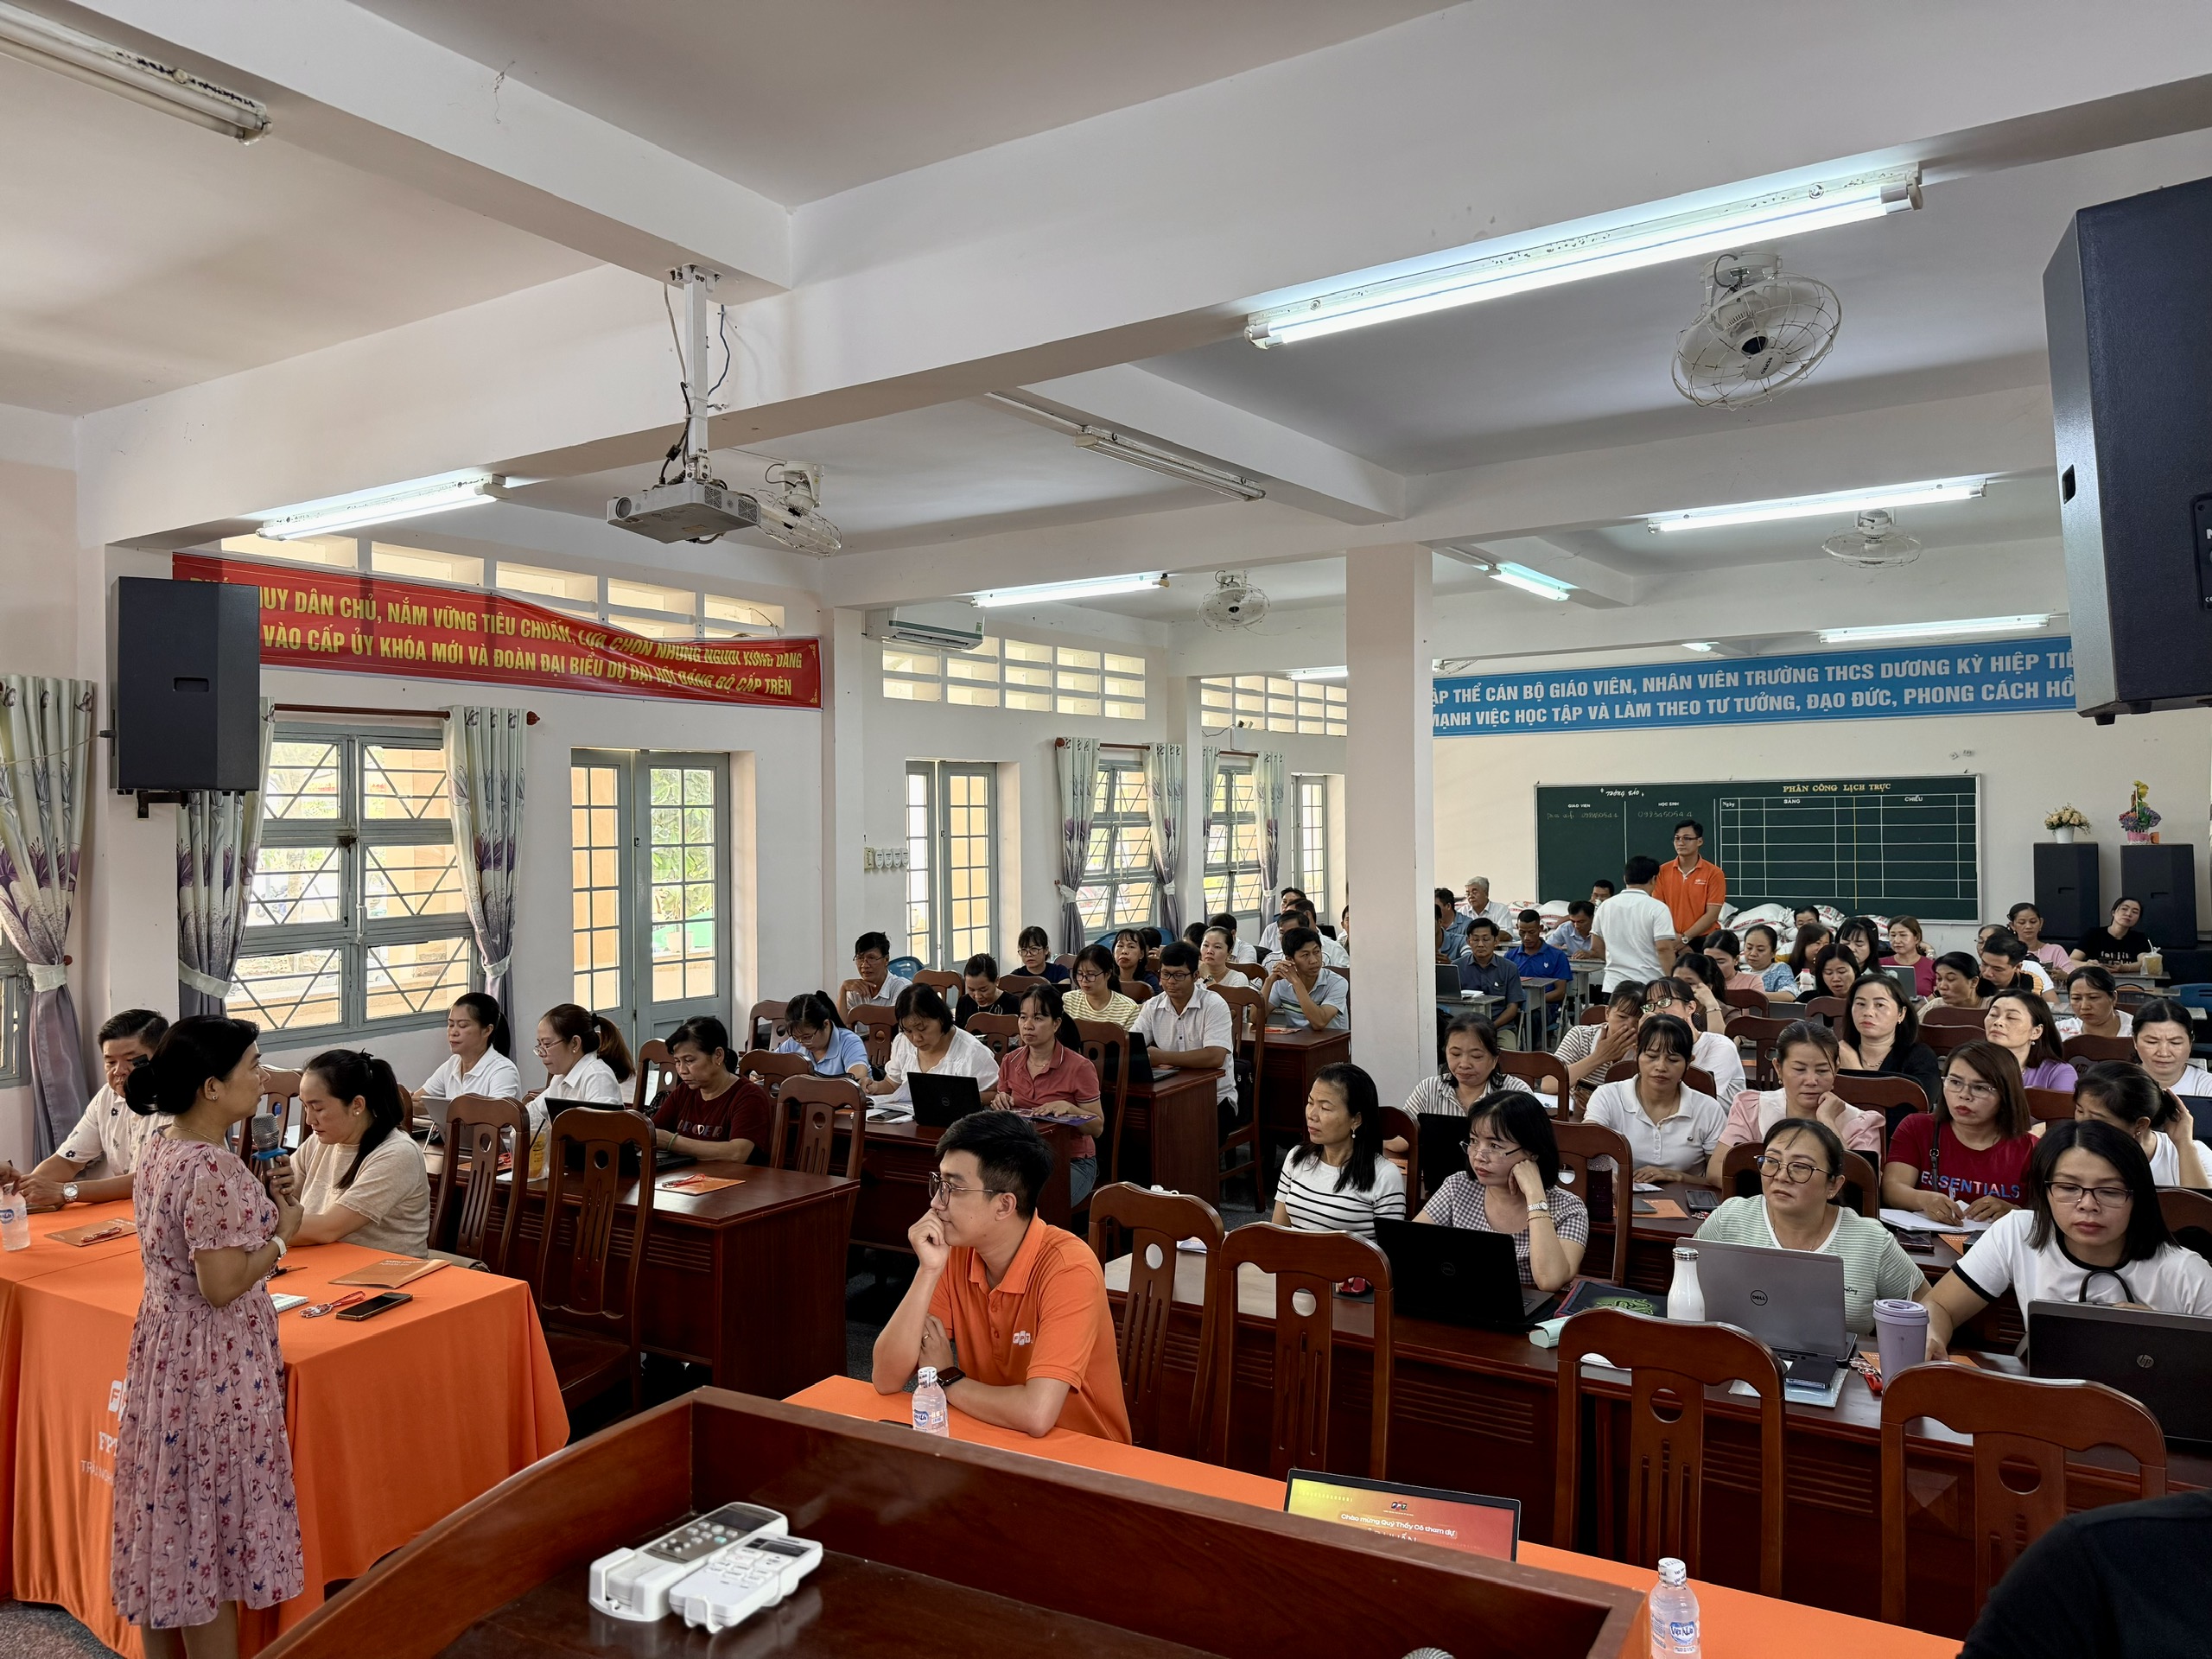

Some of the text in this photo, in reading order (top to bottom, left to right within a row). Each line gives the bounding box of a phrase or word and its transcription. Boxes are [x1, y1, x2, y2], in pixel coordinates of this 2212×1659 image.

[295, 588, 334, 616] DÂN
[340, 593, 382, 624] CHỦ,
[387, 598, 428, 627] NẮM
[433, 606, 478, 632] VỮNG
[481, 610, 516, 637] TIÊU
[262, 620, 301, 651] VÀO
[308, 622, 345, 654] CẤP
[351, 626, 375, 657] ỦY
[380, 634, 426, 661] KHÓA
[431, 640, 463, 665] MỚI
[468, 643, 489, 667] VÀ
[493, 646, 537, 671] ĐOÀN
[540, 653, 565, 677] ĐẠI
[569, 651, 604, 677] BIỂU
[607, 660, 627, 683] DỰ
[630, 663, 653, 685] ĐẠI
[715, 673, 736, 694] BỘ
[736, 671, 761, 692] CẤP
[765, 676, 792, 696] TRÊN
[1452, 682, 1482, 703] THỂ
[1485, 681, 1518, 702] CÁN
[1522, 681, 1545, 702] BỘ
[1549, 677, 1588, 698] GIÁO
[1592, 677, 1637, 696] VIÊN,
[1643, 672, 1692, 693] NHÂN
[1697, 671, 1738, 690] VIÊN
[1745, 664, 1819, 687] TRƯỜNG
[1825, 663, 1874, 683] THCS
[1880, 658, 1950, 680] DƯƠNG
[1956, 653, 1984, 675] KỲ
[1991, 651, 2040, 676] HIỆP
[1476, 707, 1510, 728] VIỆC
[1515, 708, 1547, 727] HỌC
[1551, 703, 1583, 724] TẬP
[1587, 702, 1610, 721] VÀ
[1615, 700, 1651, 719] LÀM
[1656, 699, 1700, 717] THEO
[1706, 696, 1731, 714] TƯ
[1735, 690, 1801, 714] TƯỞNG,
[1807, 691, 1846, 714] ĐẠO
[1851, 686, 1897, 709] ĐỨC,
[1904, 684, 1974, 705] PHONG
[1981, 678, 2039, 701] CÁCH
[1783, 783, 1891, 793] PHÂN CÔNG LỊCH TRỰC
[1921, 1170, 2020, 1199] ESSENTIALS
[1013, 1331, 1032, 1345] FPT
[1425, 1526, 1445, 1535] tham
